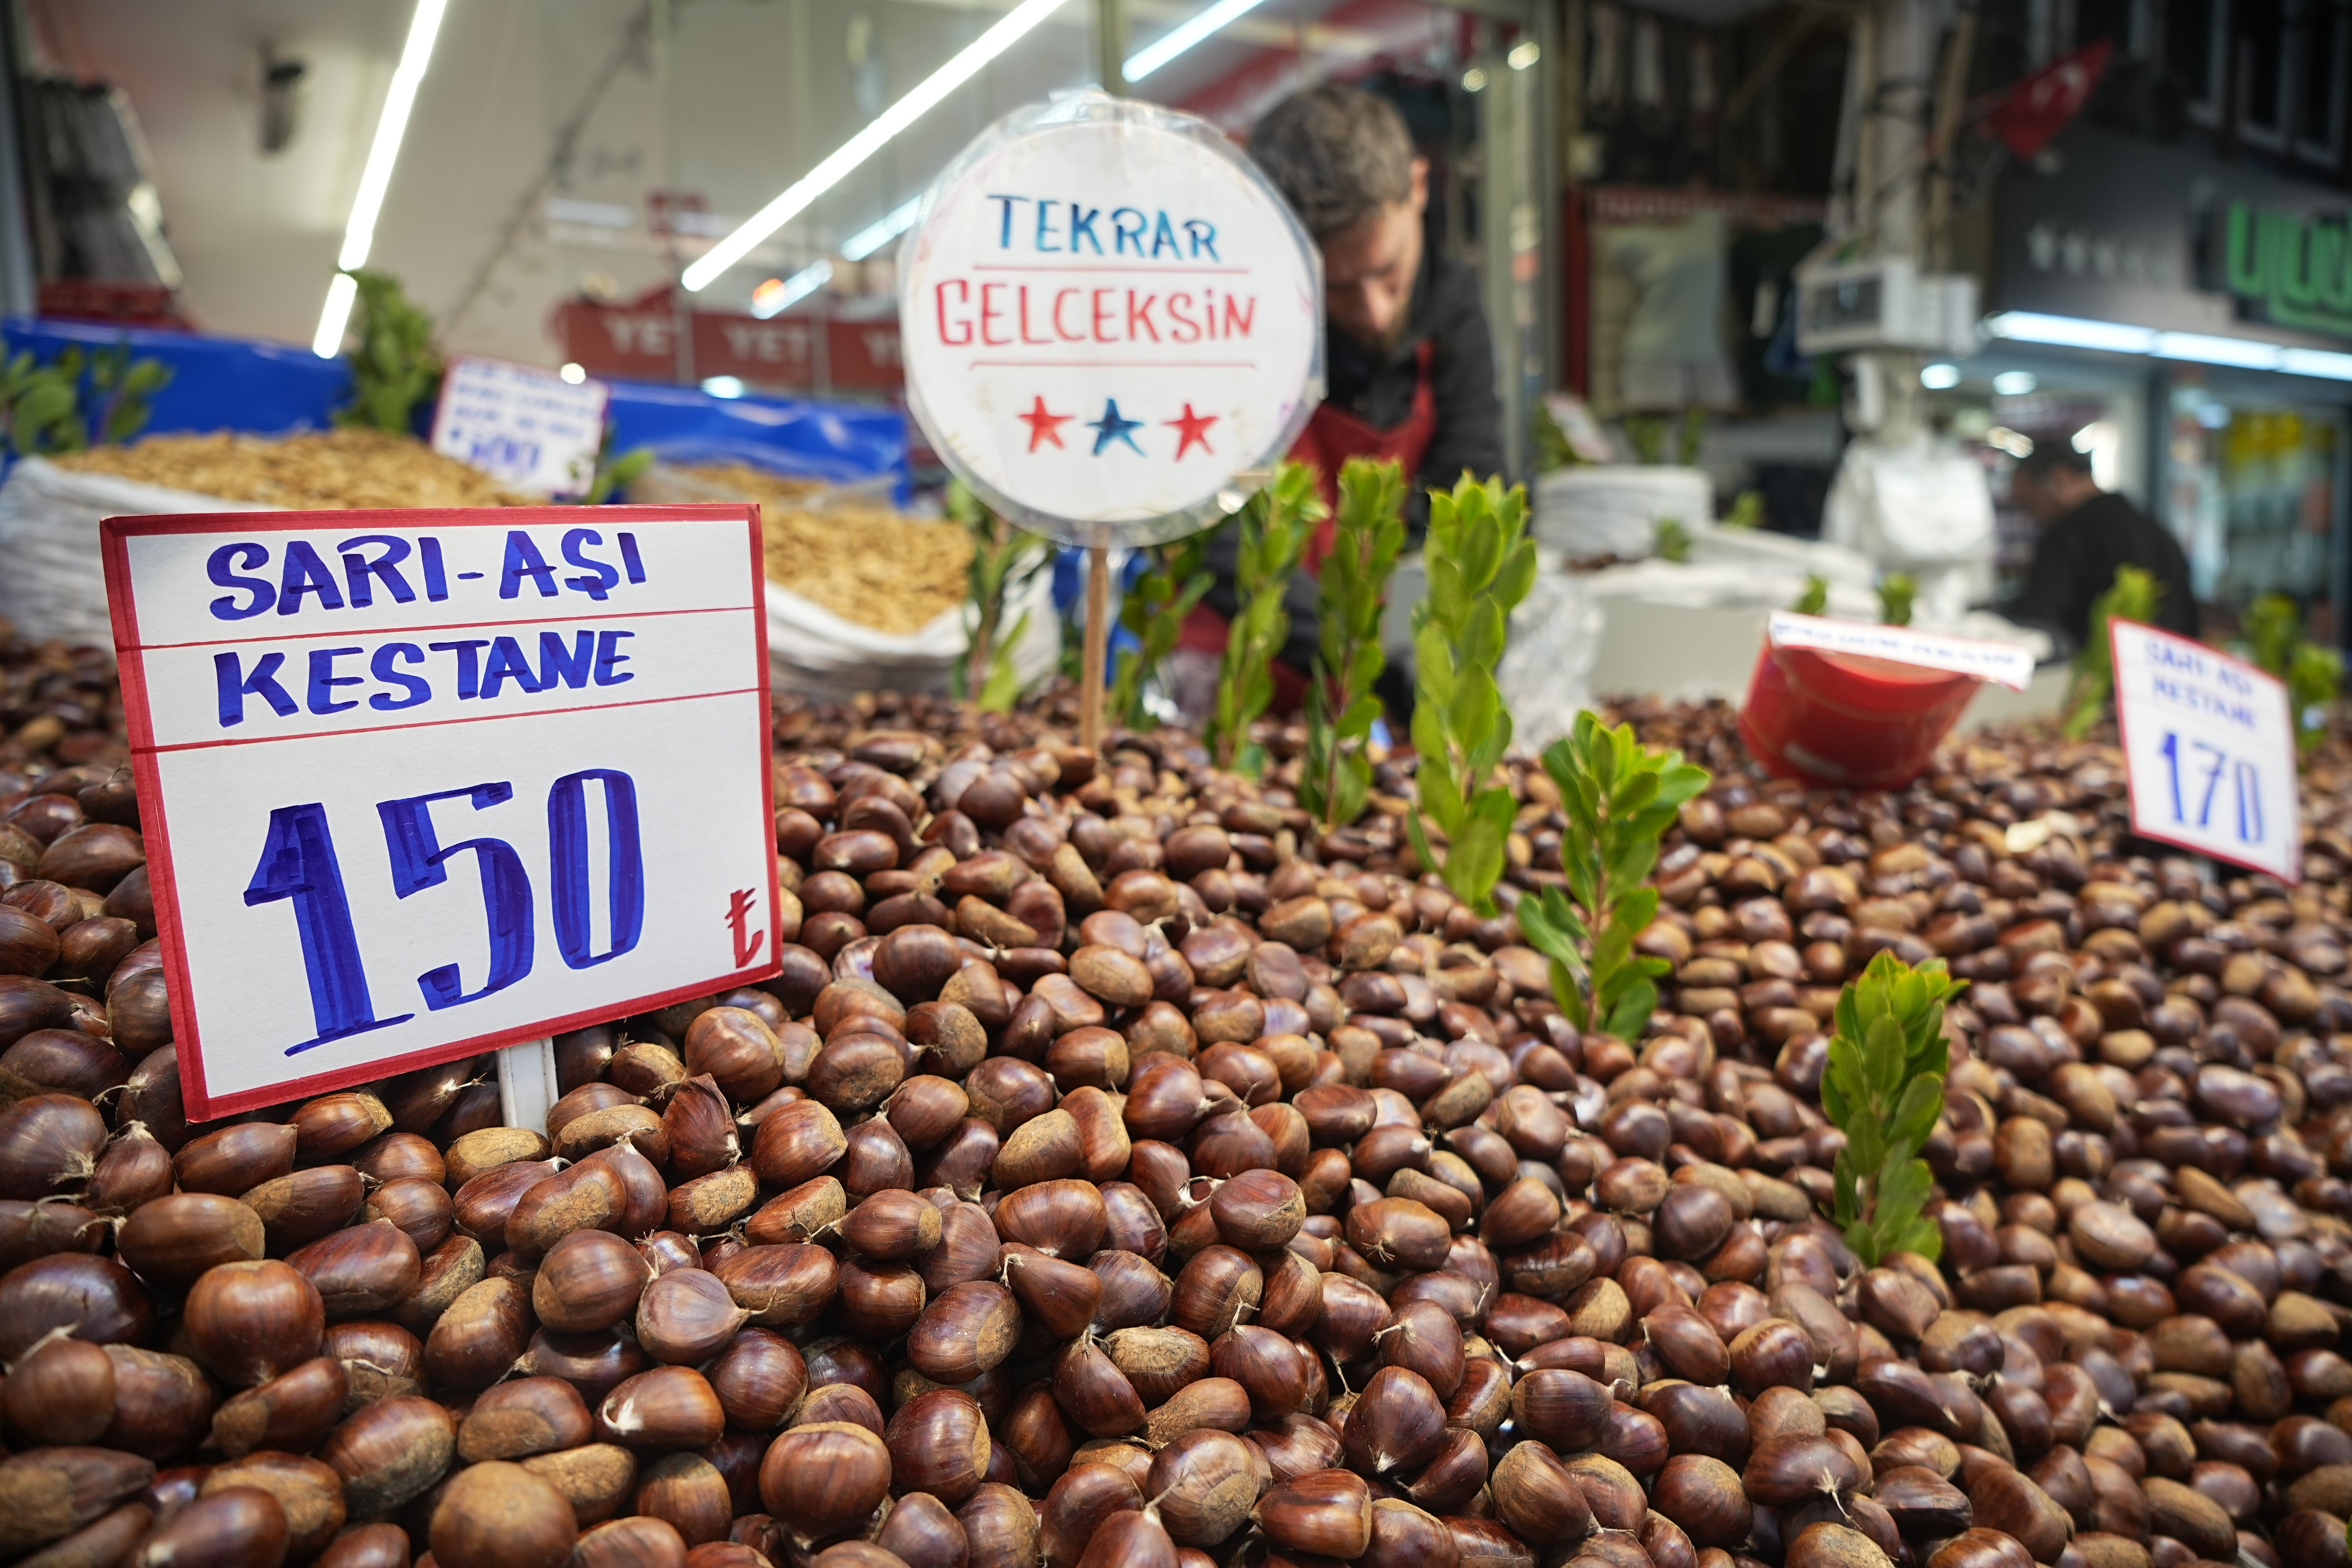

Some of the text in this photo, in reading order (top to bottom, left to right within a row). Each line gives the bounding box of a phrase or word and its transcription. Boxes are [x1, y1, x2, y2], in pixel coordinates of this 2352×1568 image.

[987, 194, 1220, 262] TEKRAR
[207, 528, 647, 621] SARI-AŞI
[213, 629, 635, 728] KESTANE
[2159, 730, 2263, 844] 170
[243, 768, 645, 1057] 150
